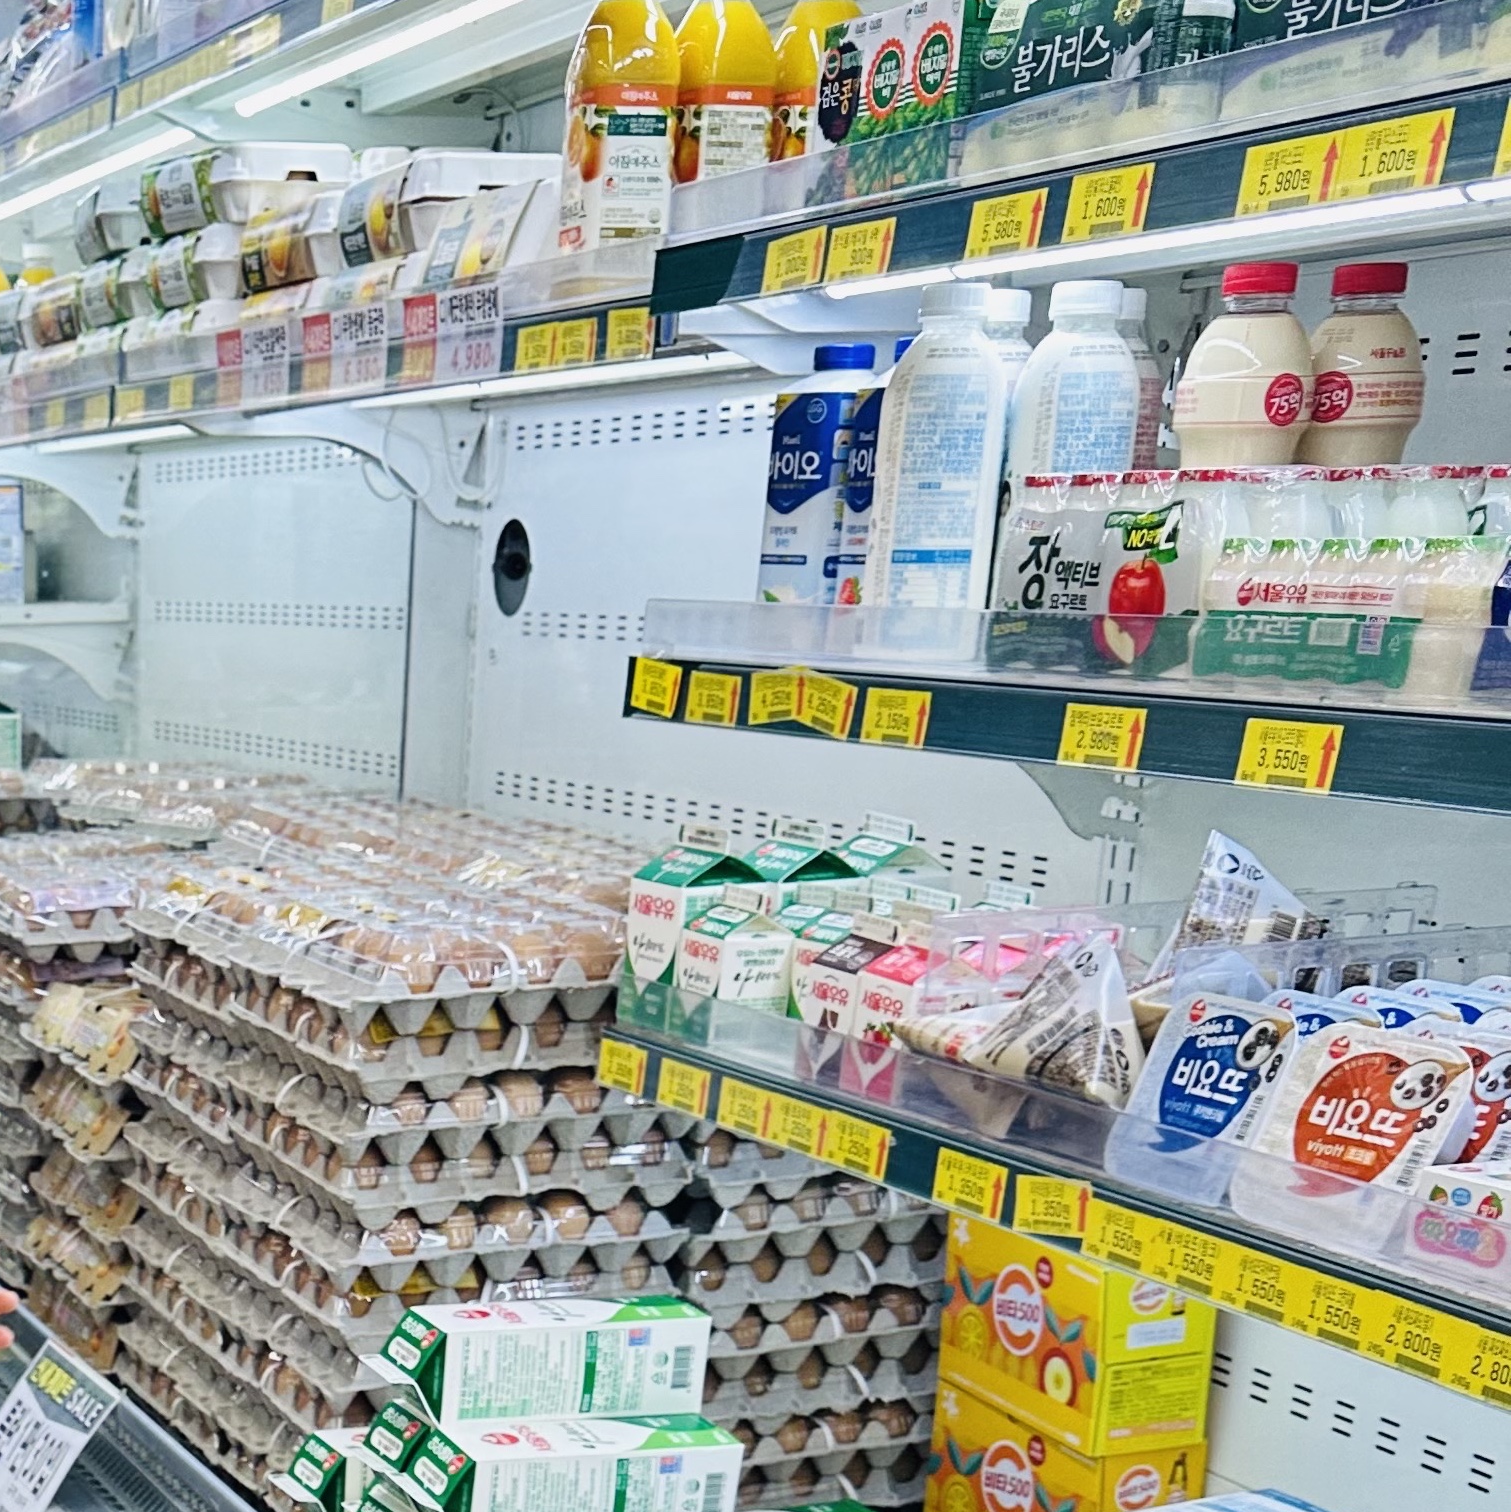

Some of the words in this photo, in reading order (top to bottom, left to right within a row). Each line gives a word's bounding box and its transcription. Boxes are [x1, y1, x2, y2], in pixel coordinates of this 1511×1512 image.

[1011, 25, 1111, 93] 불가리스
[1268, 391, 1302, 418] 75억
[1018, 531, 1061, 609] 장
[1055, 561, 1101, 590] 액티브
[1253, 582, 1308, 604] 서울우유
[1196, 1034, 1239, 1048] Cream
[1172, 1056, 1248, 1105] 비요뜨
[1309, 1093, 1406, 1147] 비요뜨
[1307, 1140, 1344, 1157] viyott
[66, 1388, 104, 1428] SALE
